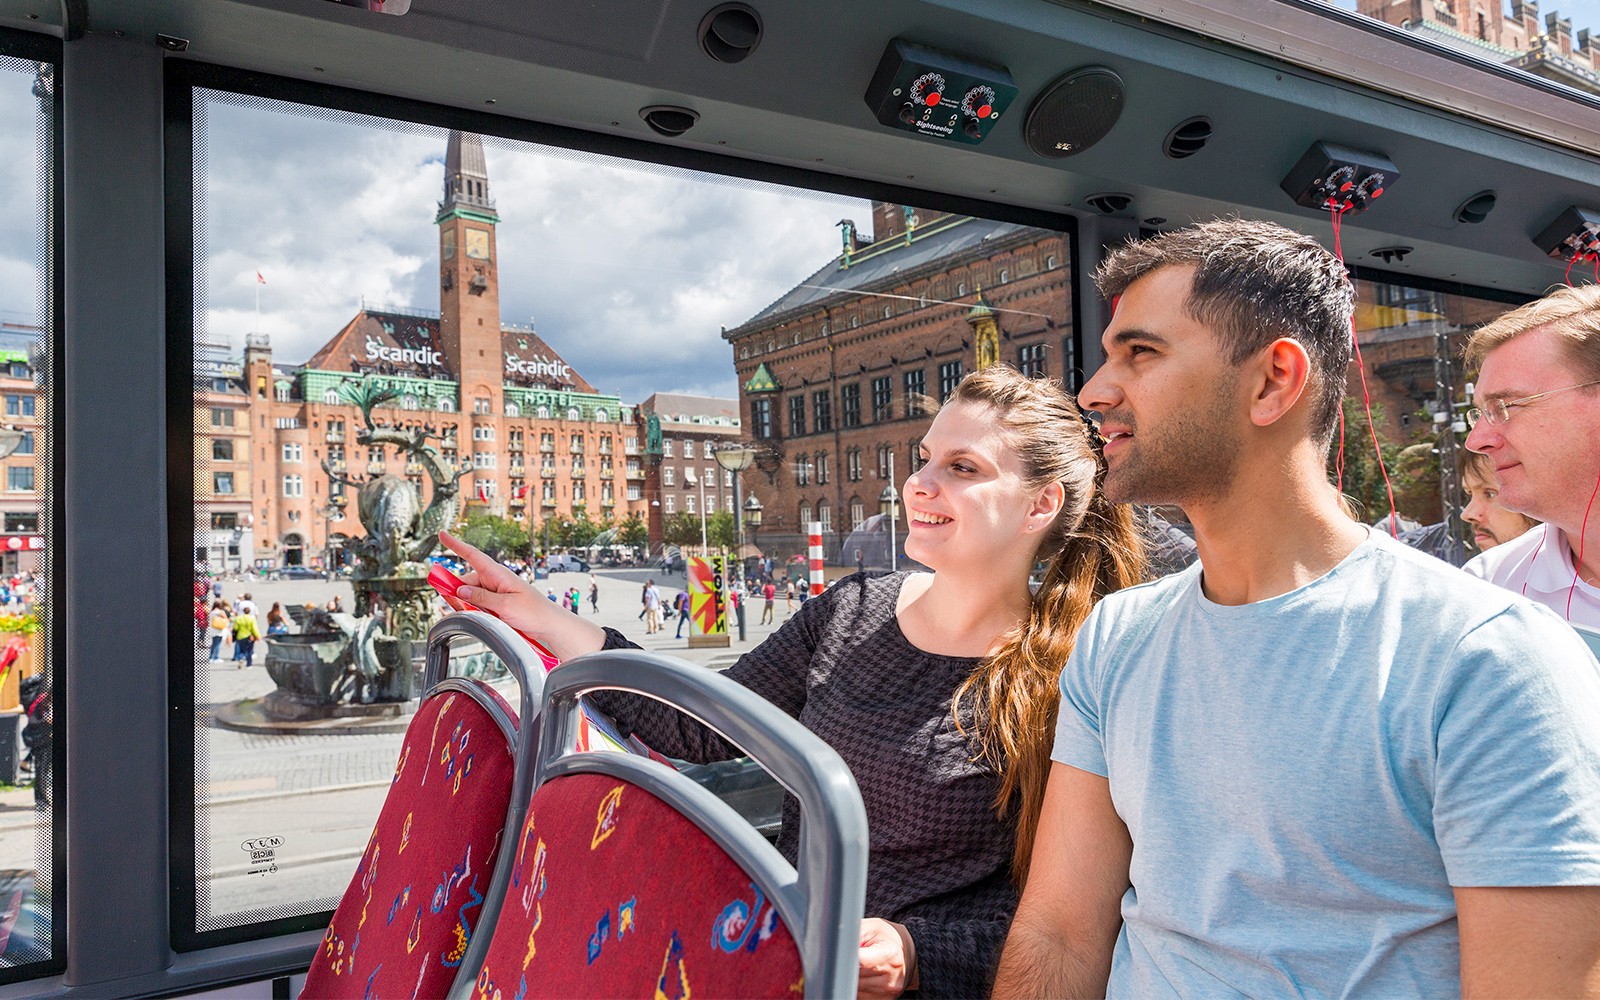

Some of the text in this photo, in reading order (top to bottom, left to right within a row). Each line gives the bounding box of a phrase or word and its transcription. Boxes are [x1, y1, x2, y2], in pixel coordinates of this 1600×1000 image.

[916, 121, 953, 134] Sightseeing
[365, 341, 442, 365] Scandic
[505, 355, 571, 378] Scandic
[375, 379, 579, 406] LACE HOTEL
